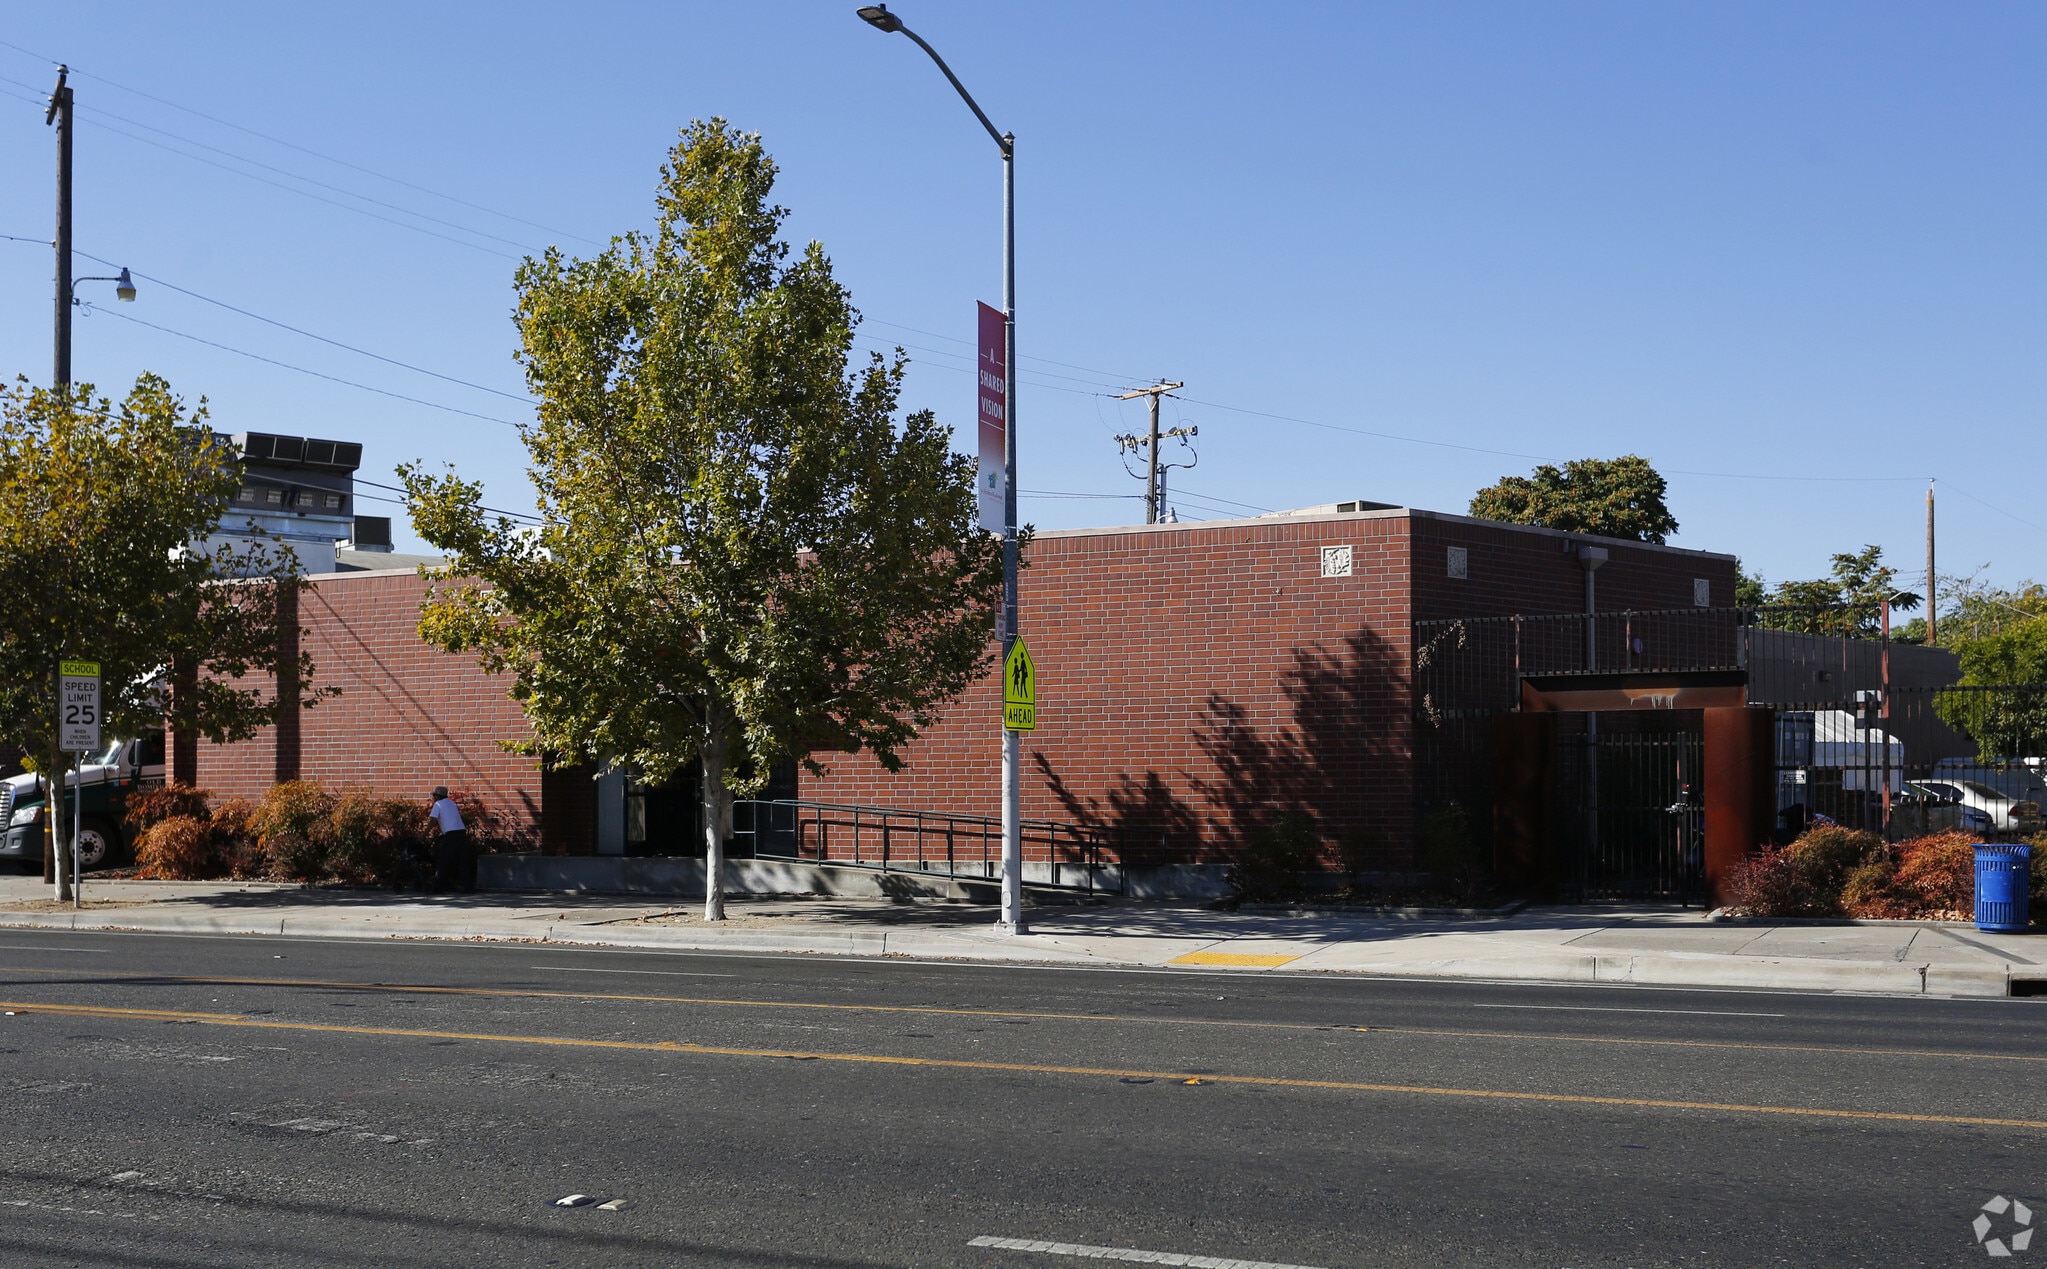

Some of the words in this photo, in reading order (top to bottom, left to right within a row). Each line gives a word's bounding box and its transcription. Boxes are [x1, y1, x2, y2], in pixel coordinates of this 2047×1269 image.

[989, 347, 995, 363] A
[980, 369, 1004, 394] SHARED
[981, 397, 1003, 420] VISION
[64, 664, 96, 674] SCHOOL
[65, 682, 96, 691] SPEED
[68, 694, 92, 702] LIMIT
[66, 705, 95, 725] 25
[1009, 708, 1032, 723] AHEAD
